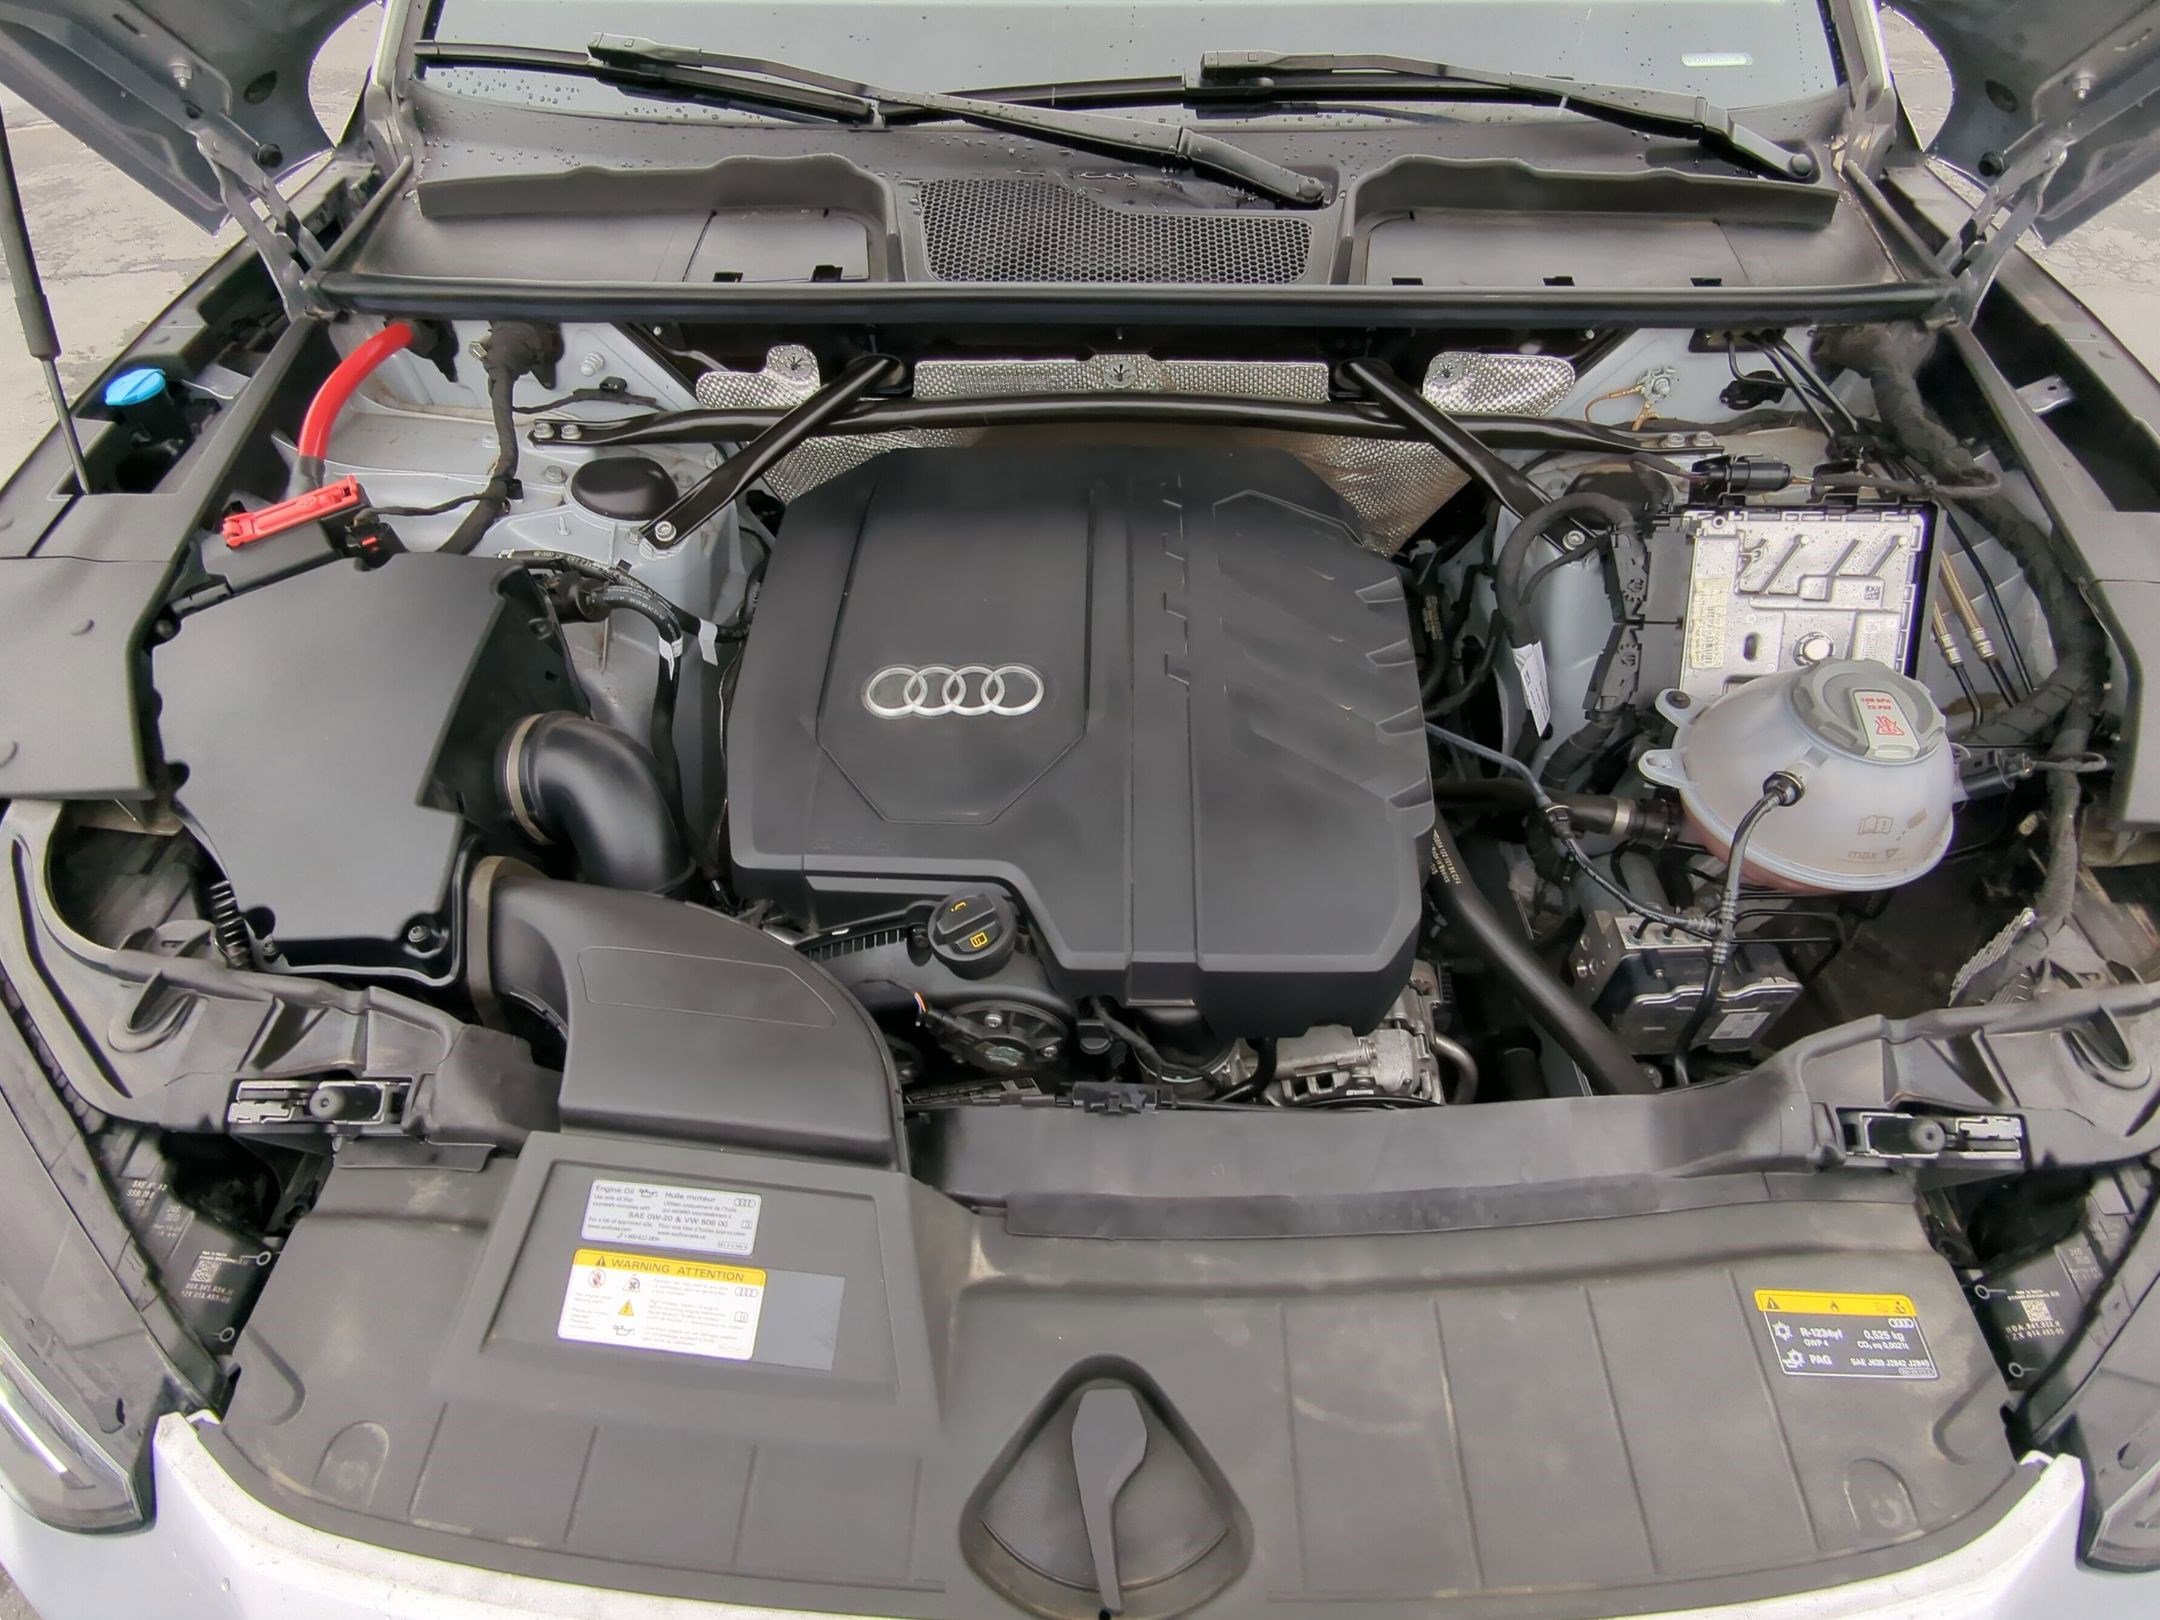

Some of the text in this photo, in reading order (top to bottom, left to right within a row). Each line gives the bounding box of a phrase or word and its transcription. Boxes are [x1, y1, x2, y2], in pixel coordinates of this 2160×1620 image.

[596, 1185, 635, 1195] Engine Oil
[628, 1211, 646, 1219] SAE
[647, 1214, 673, 1222] 0W-20
[684, 1216, 699, 1225] VW
[611, 1259, 745, 1282] WARNING ATTENTION
[1863, 1329, 1892, 1341] 0,525
[1891, 1330, 1906, 1342] kg
[1808, 1353, 1833, 1366] PAG
